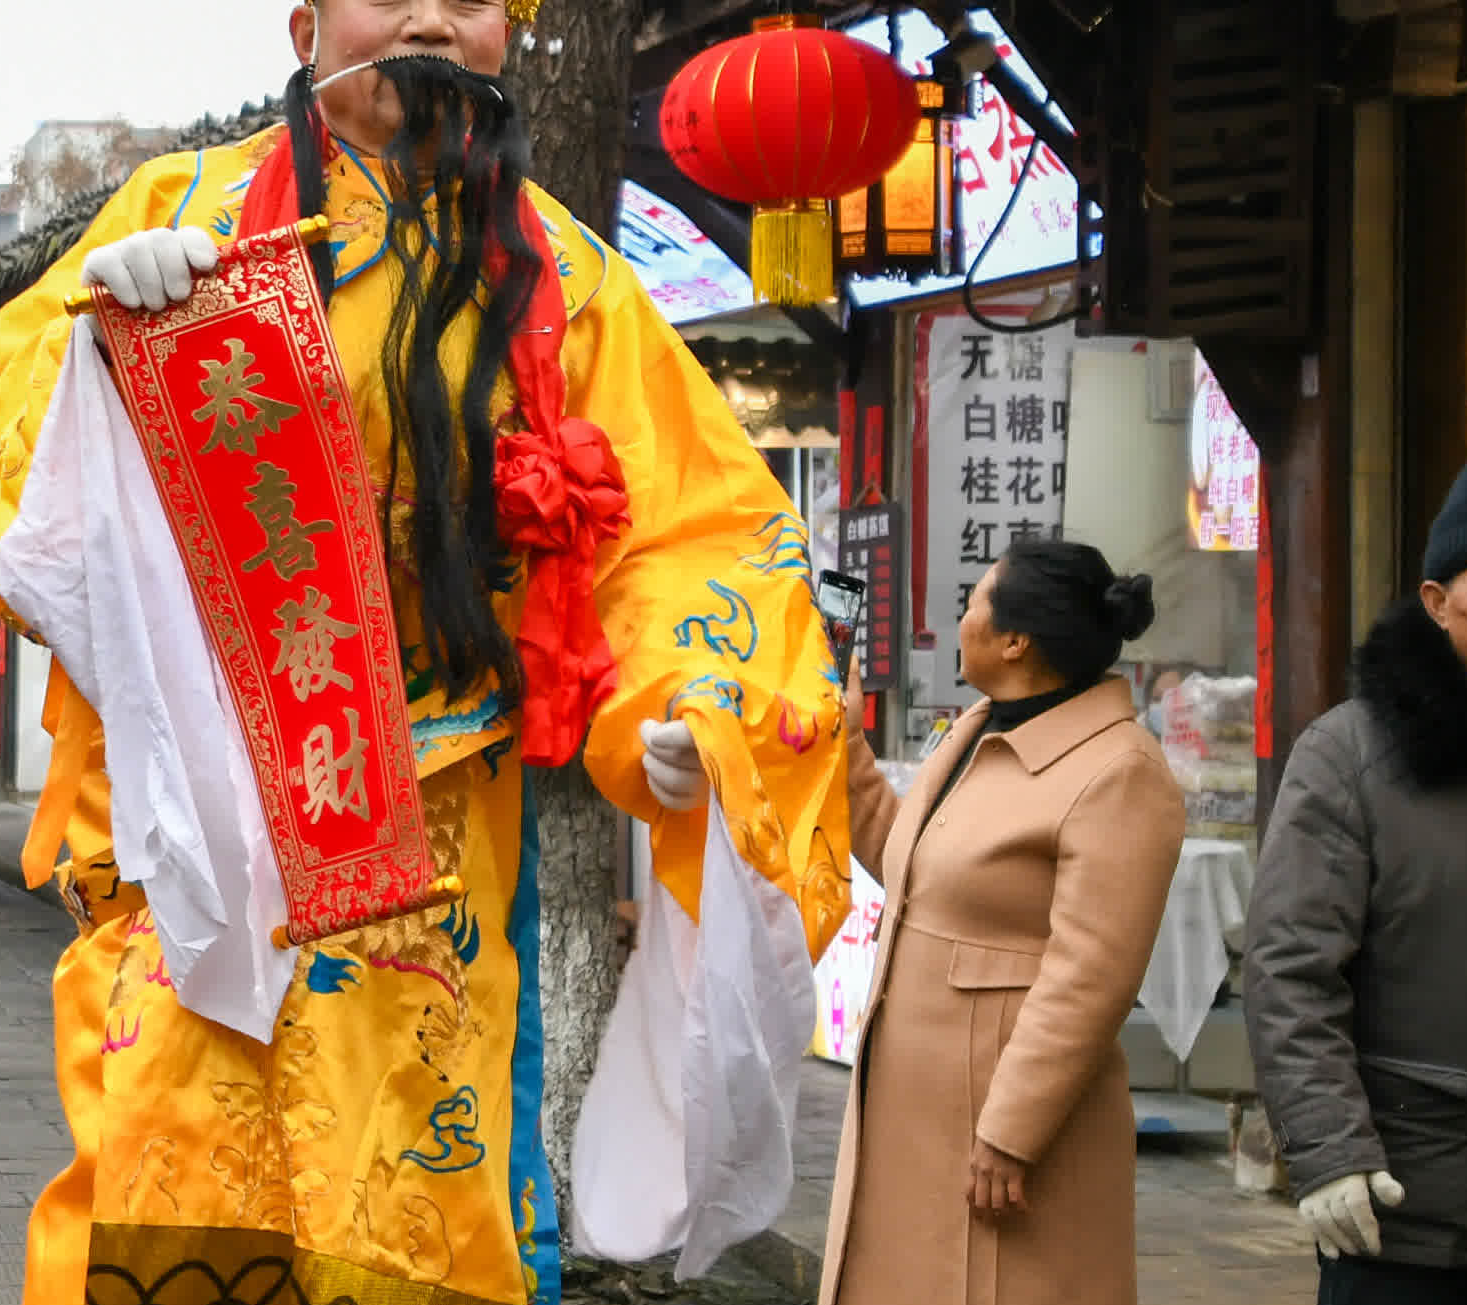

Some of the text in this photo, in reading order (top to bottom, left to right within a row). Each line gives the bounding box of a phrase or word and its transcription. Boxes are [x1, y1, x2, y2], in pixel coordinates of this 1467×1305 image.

[961, 334, 1045, 382] 无糖
[192, 337, 371, 824] 恭喜發財
